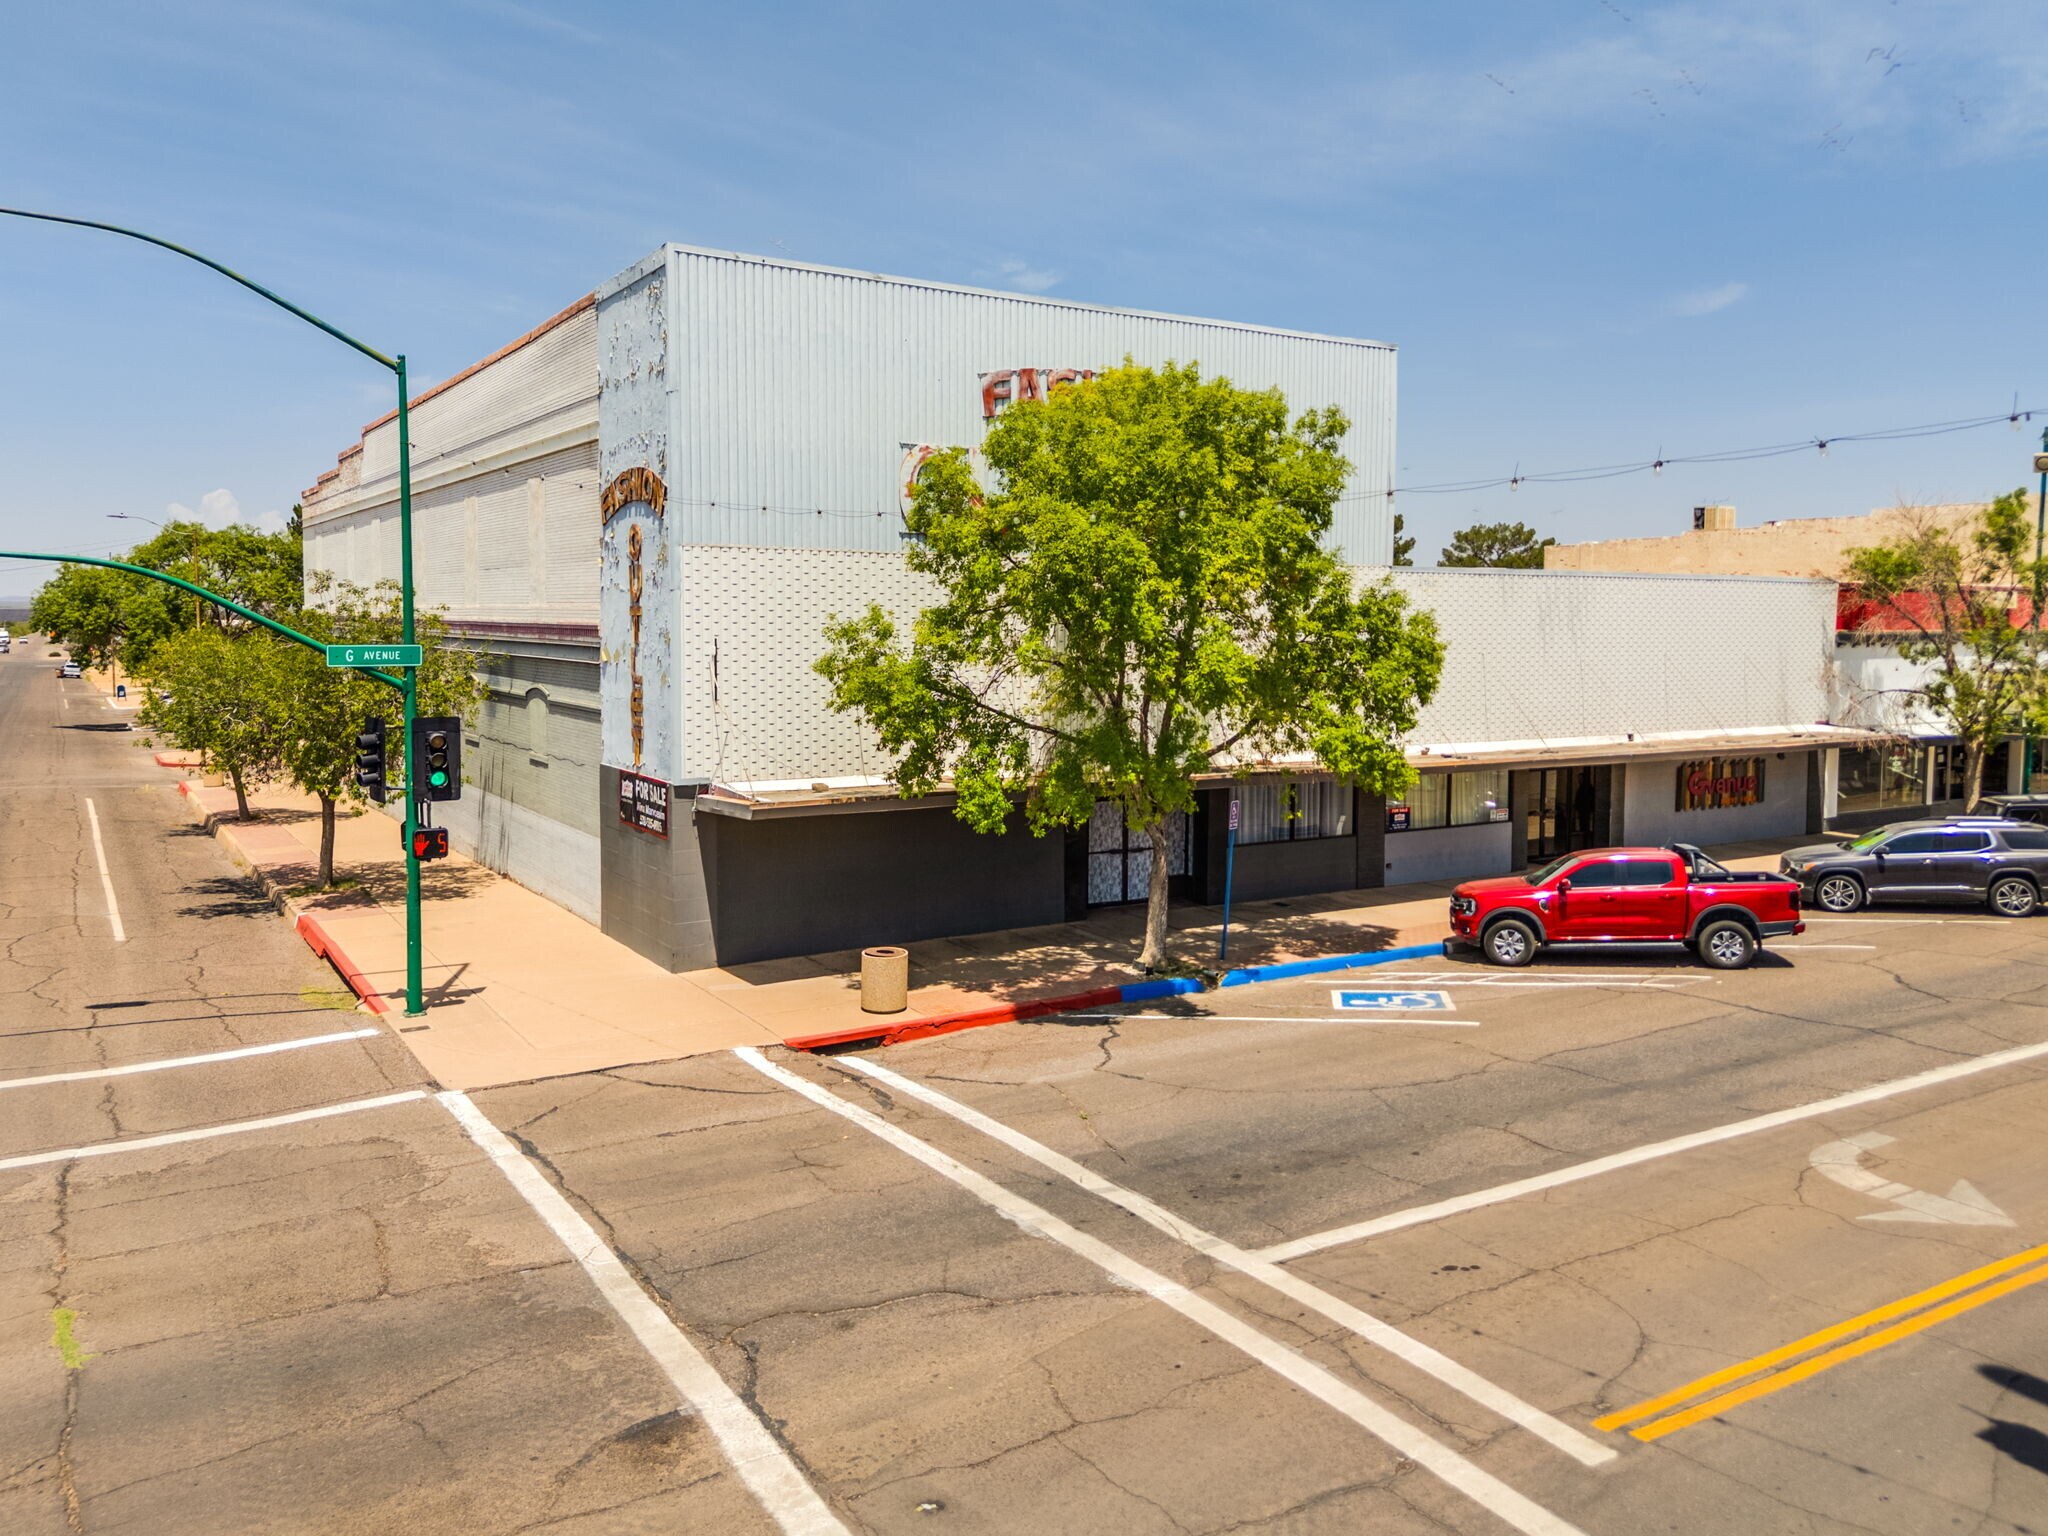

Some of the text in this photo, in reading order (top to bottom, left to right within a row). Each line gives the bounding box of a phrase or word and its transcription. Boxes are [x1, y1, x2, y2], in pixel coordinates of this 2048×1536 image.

[982, 368, 1095, 417] FA
[600, 466, 668, 526] FASHION
[345, 649, 401, 662] G AVENUE
[629, 525, 644, 766] OUTLET
[635, 779, 649, 801] FOR
[650, 784, 667, 807] SALE
[437, 833, 447, 853] 5
